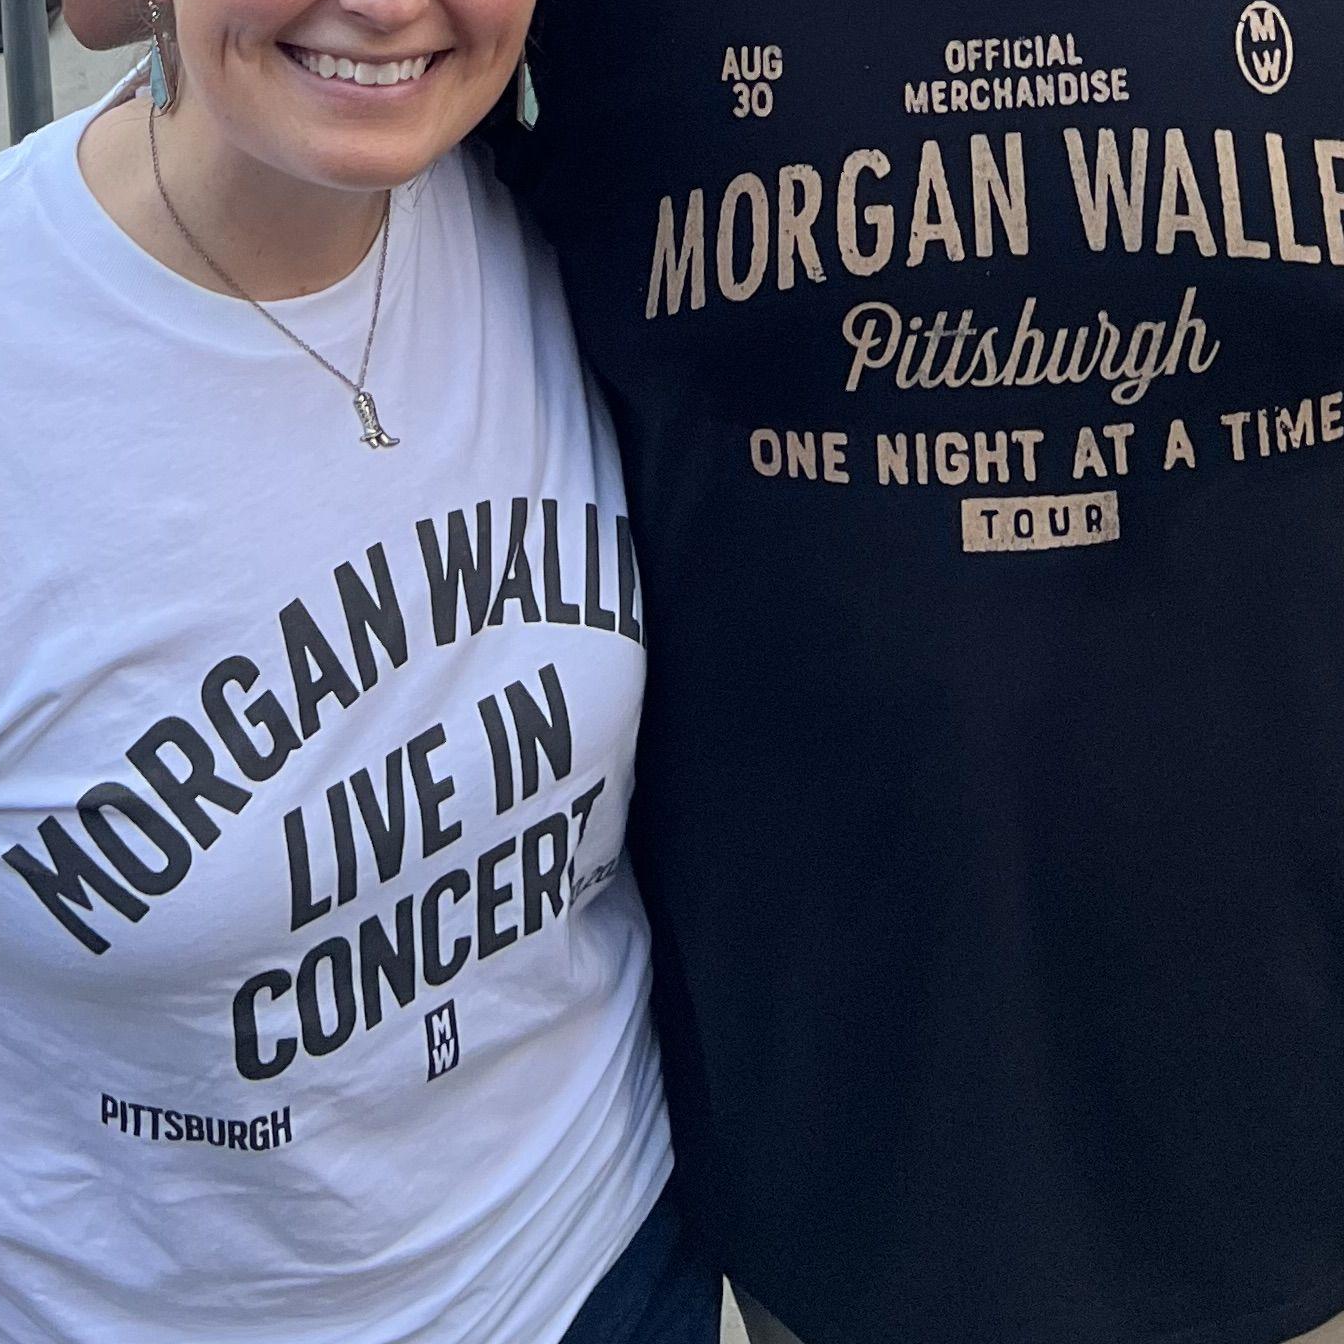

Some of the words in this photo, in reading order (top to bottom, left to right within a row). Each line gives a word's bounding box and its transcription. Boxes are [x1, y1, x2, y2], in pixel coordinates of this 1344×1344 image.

[721, 44, 784, 82] AUG
[944, 32, 1083, 74] OFFICIAL
[731, 81, 774, 118] 30
[904, 67, 1131, 115] MERCHANDISE
[645, 130, 1029, 320] MORGAN
[842, 285, 1220, 405] Pittsburgh
[749, 427, 849, 484] ONE
[877, 427, 1044, 487] NIGHT
[1072, 422, 1136, 480] AT
[1163, 418, 1197, 470] A
[979, 502, 1104, 540] TOUR
[1, 541, 409, 955] MORGAN
[283, 723, 463, 932] LIVE
[476, 663, 573, 816] IN
[232, 777, 606, 1081] CONCERT
[100, 1092, 292, 1152] PITTSBURGH
